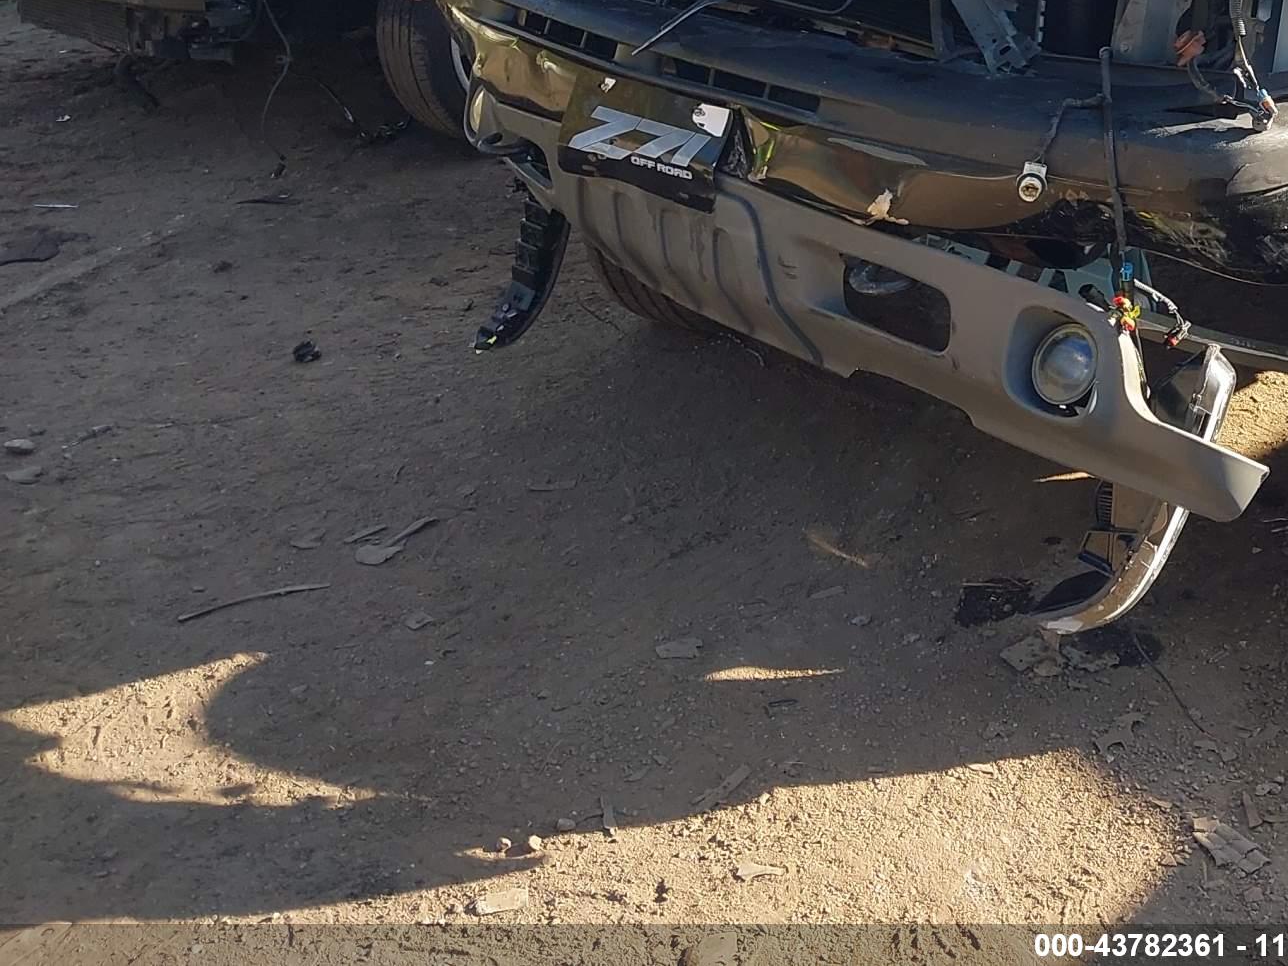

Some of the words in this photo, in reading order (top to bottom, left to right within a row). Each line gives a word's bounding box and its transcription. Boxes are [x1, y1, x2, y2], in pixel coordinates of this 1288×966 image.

[568, 105, 712, 167] Z71
[631, 156, 656, 169] OFF
[657, 163, 693, 180] ROAD
